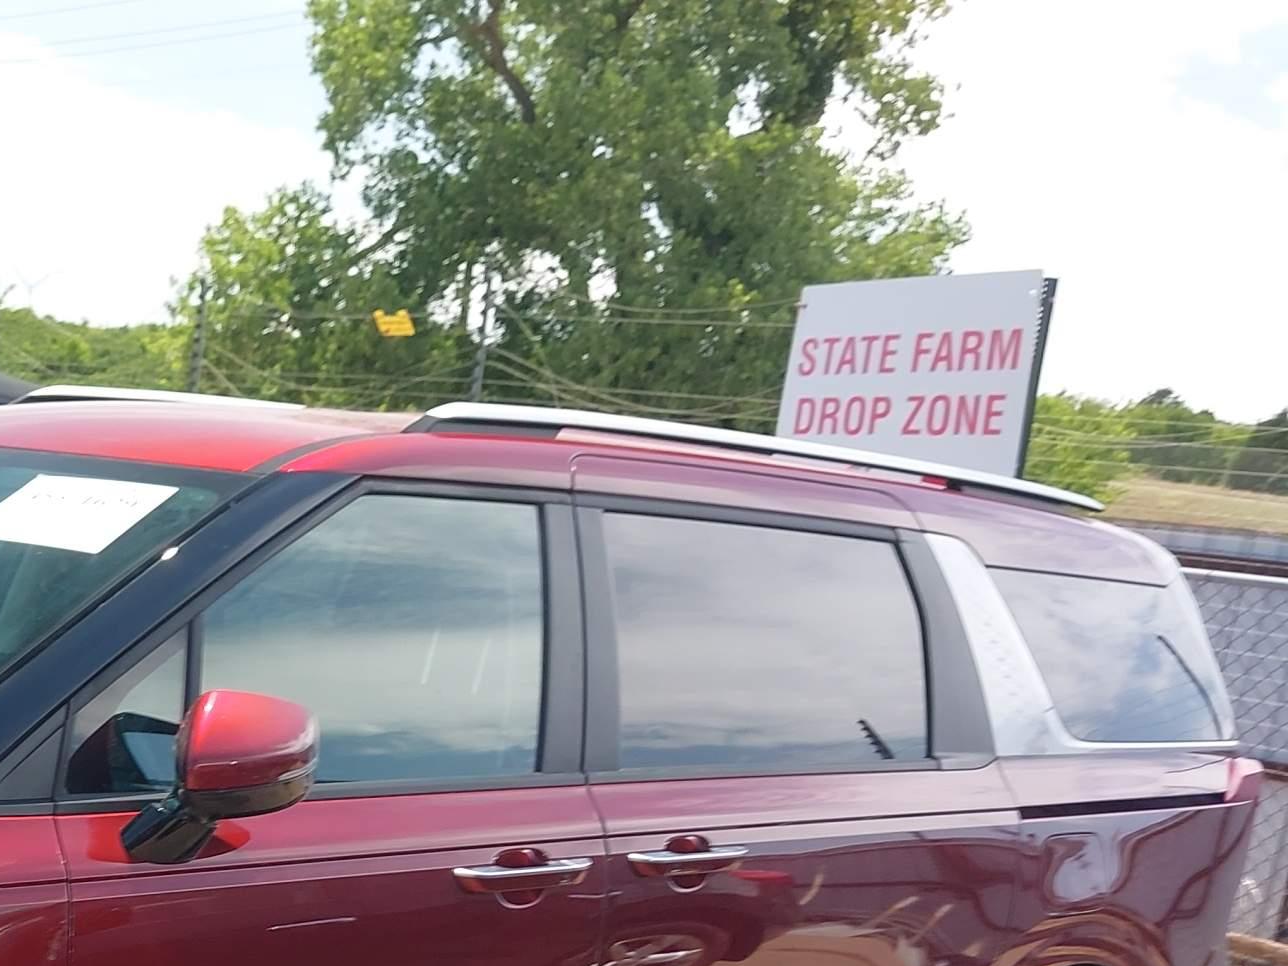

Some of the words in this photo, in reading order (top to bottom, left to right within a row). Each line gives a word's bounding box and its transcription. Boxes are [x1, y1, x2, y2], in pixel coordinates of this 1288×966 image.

[798, 334, 901, 376] STATE
[910, 328, 1025, 373] FARM
[793, 396, 892, 435] DROP
[901, 394, 1008, 436] ZONE
